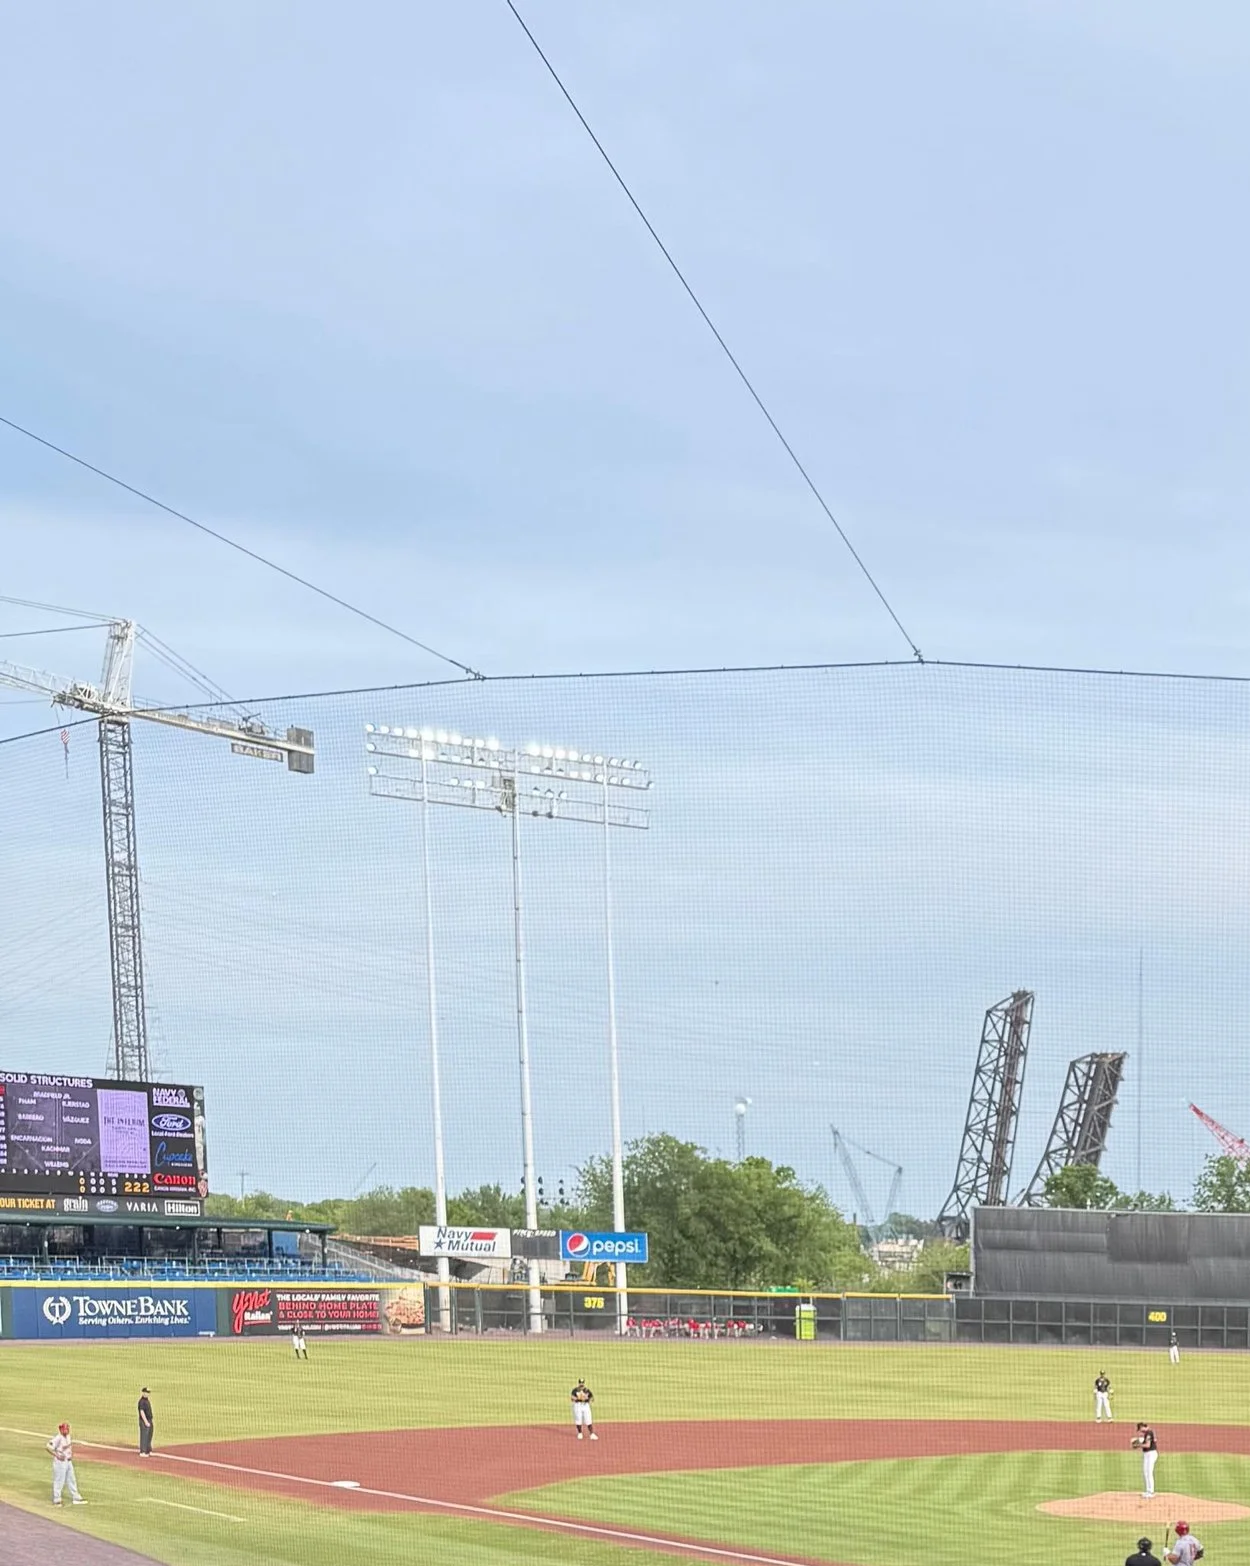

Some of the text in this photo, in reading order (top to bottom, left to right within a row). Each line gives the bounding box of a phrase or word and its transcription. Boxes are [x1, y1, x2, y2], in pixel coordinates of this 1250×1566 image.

[0, 1073, 93, 1088] SOLID STRUCTURES
[153, 1087, 176, 1097] NAVY
[153, 1096, 190, 1106] FEDERAL
[160, 1115, 184, 1128] Ford
[153, 1173, 196, 1185] Canon
[17, 1198, 44, 1209] TICKET
[44, 1199, 56, 1209] AT
[126, 1202, 158, 1212] VARIA
[166, 1202, 198, 1214] Hilton
[436, 1226, 471, 1242] Navy
[535, 1229, 557, 1237] SPEED
[447, 1240, 497, 1252] Mutual
[592, 1238, 641, 1254] pepsi
[278, 1302, 379, 1310] BEHIND HOME PLATE
[328, 1311, 351, 1319] YOUR
[353, 1311, 379, 1319] HOME!
[1148, 1311, 1167, 1322] 400
[78, 1316, 107, 1327] Serving
[108, 1316, 134, 1325] Others.
[135, 1316, 170, 1327] Enriching
